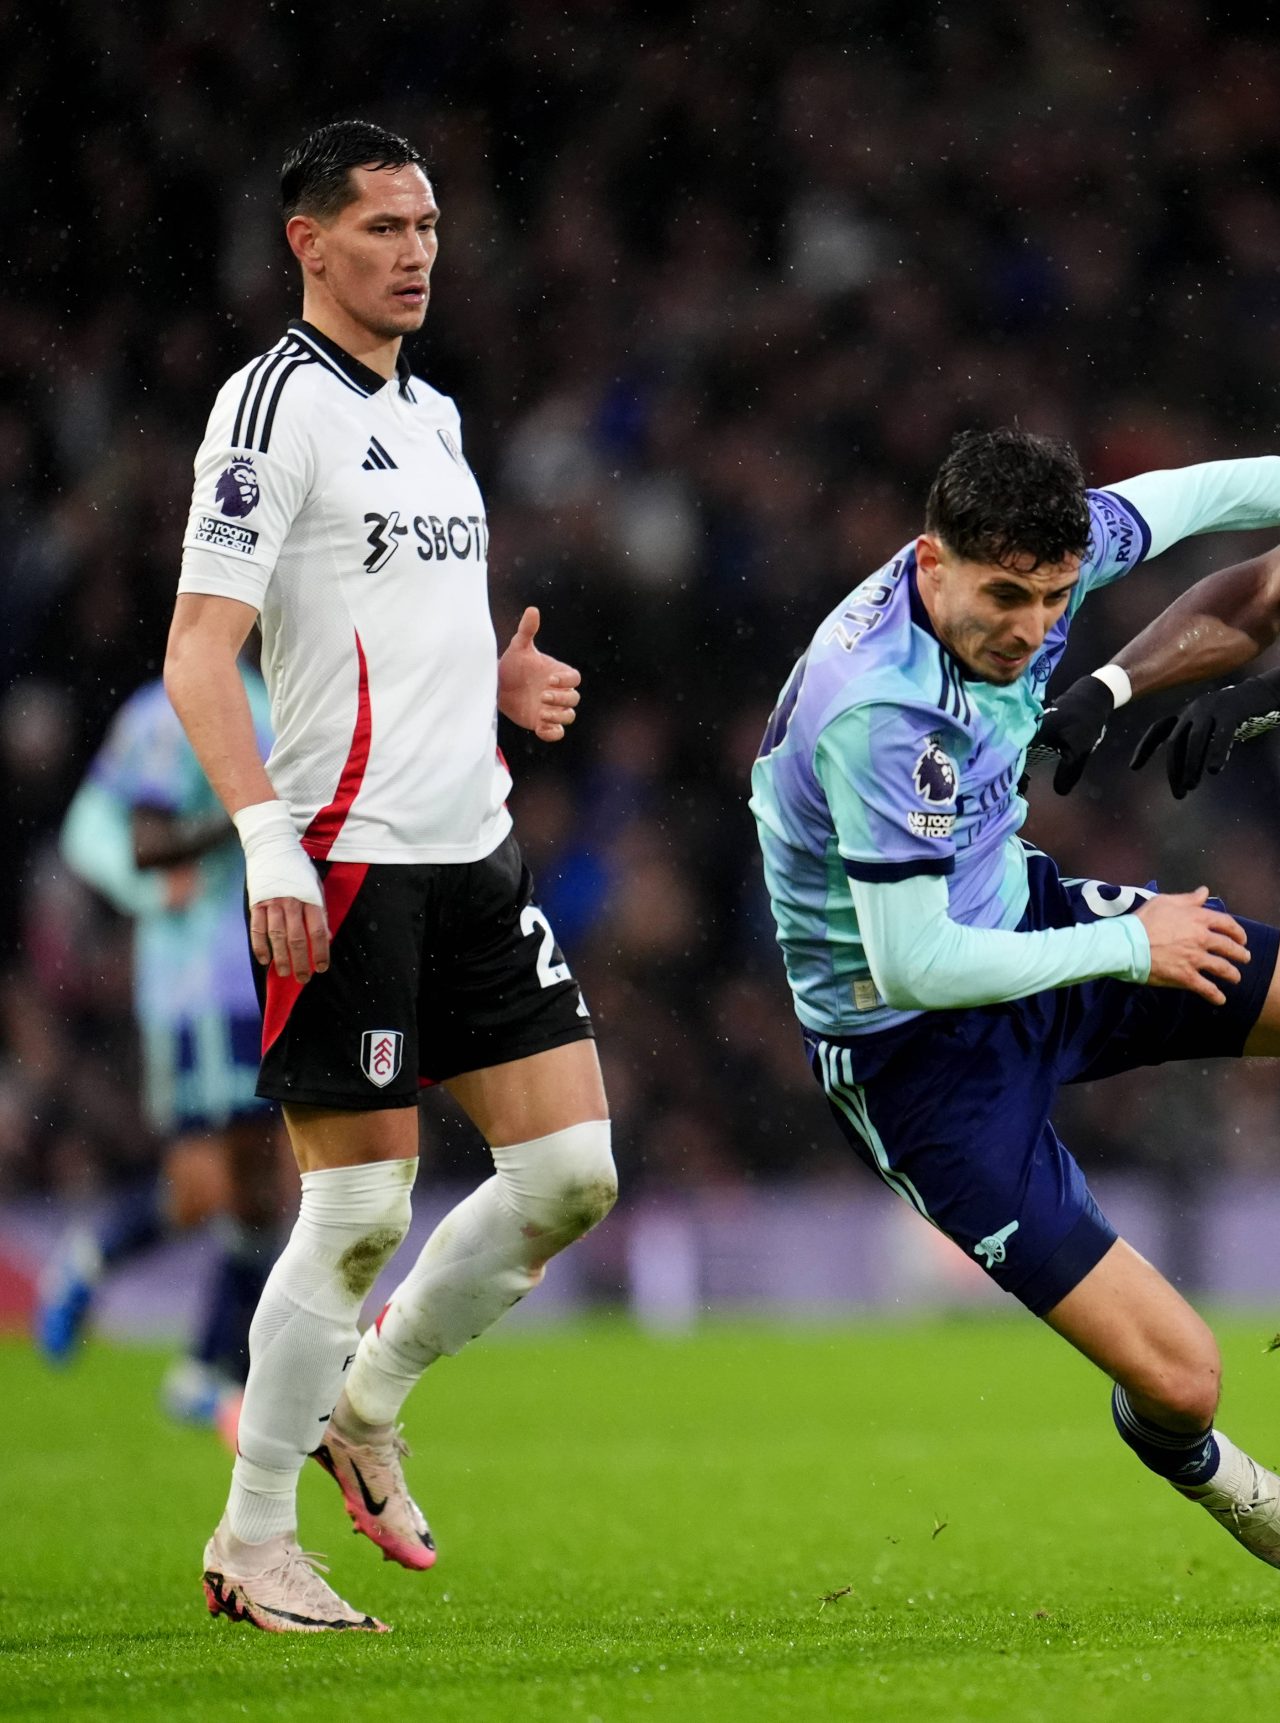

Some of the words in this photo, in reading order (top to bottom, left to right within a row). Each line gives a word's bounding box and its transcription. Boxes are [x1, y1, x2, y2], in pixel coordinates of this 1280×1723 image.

[199, 516, 215, 531] No
[214, 523, 252, 543] room
[413, 515, 487, 562] SBOT
[209, 533, 255, 555] racism
[907, 812, 927, 826] No
[519, 905, 572, 989] 2
